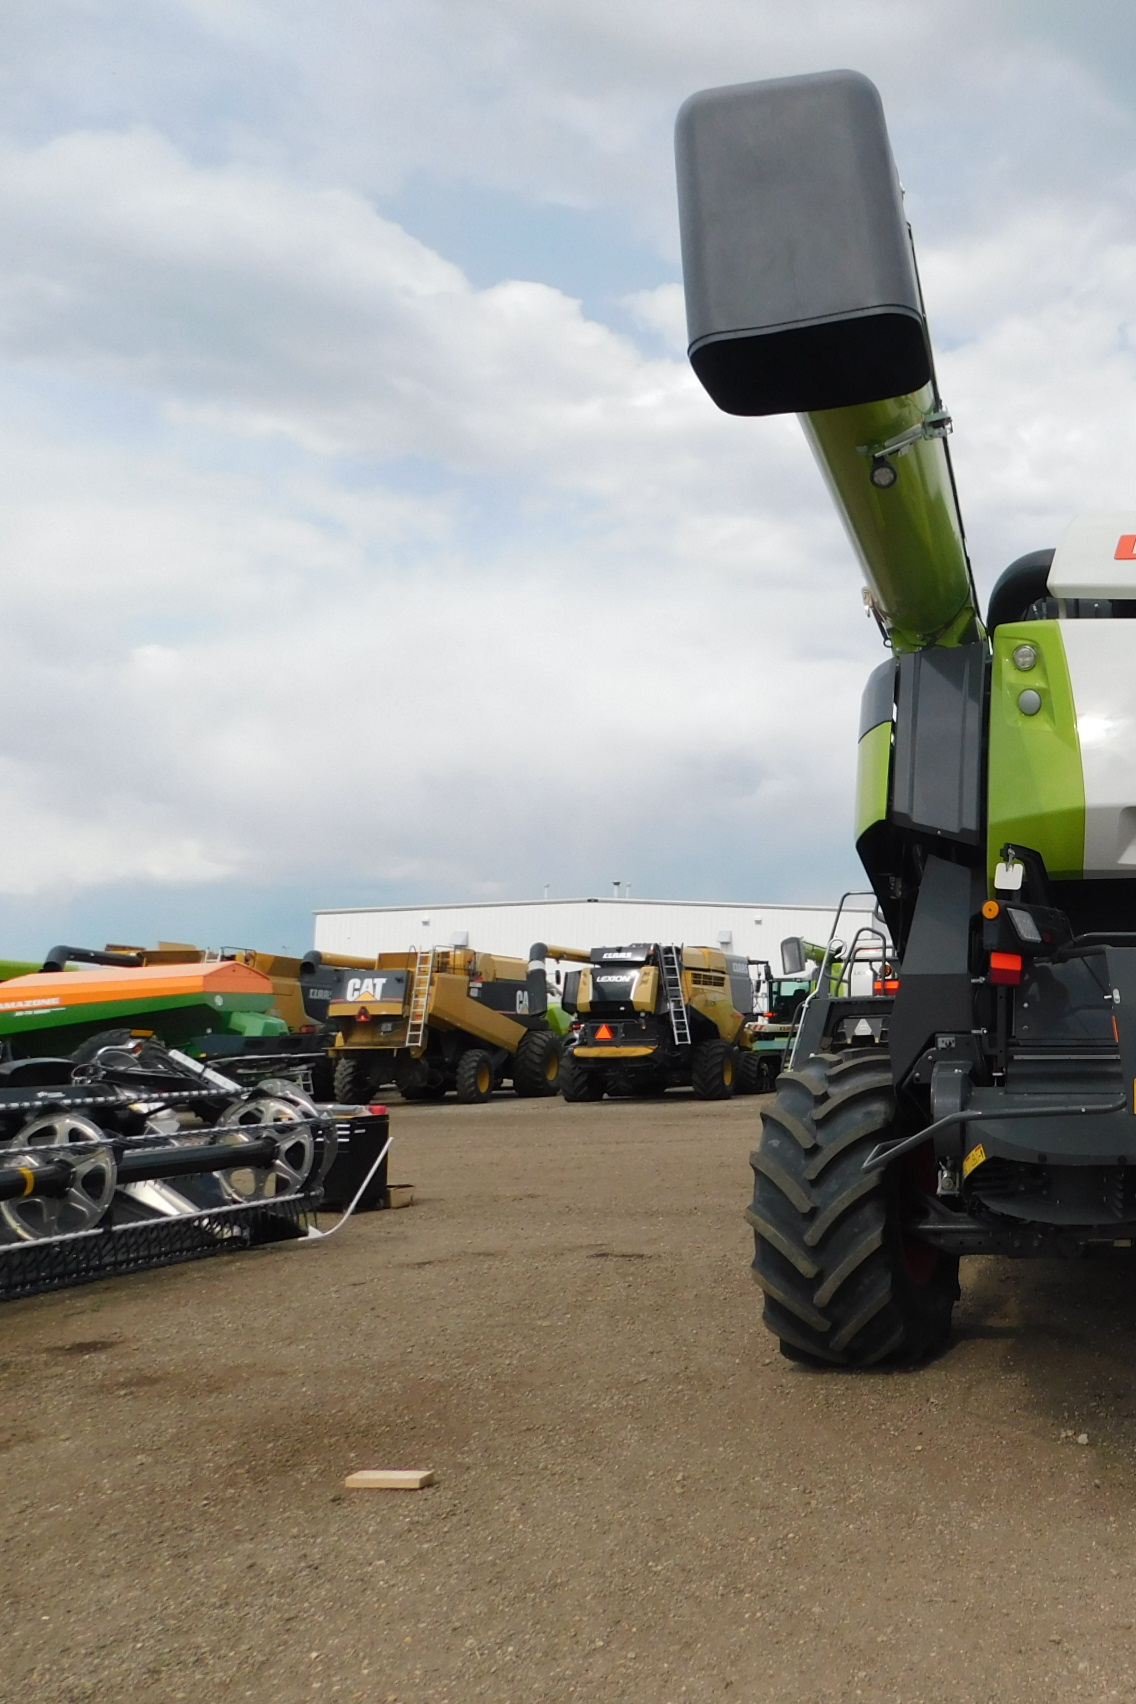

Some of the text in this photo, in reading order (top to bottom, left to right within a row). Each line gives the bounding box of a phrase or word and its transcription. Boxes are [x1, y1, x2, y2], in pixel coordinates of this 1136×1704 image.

[346, 977, 388, 1002] CAT
[596, 975, 631, 983] LEXION
[516, 989, 530, 1015] CA
